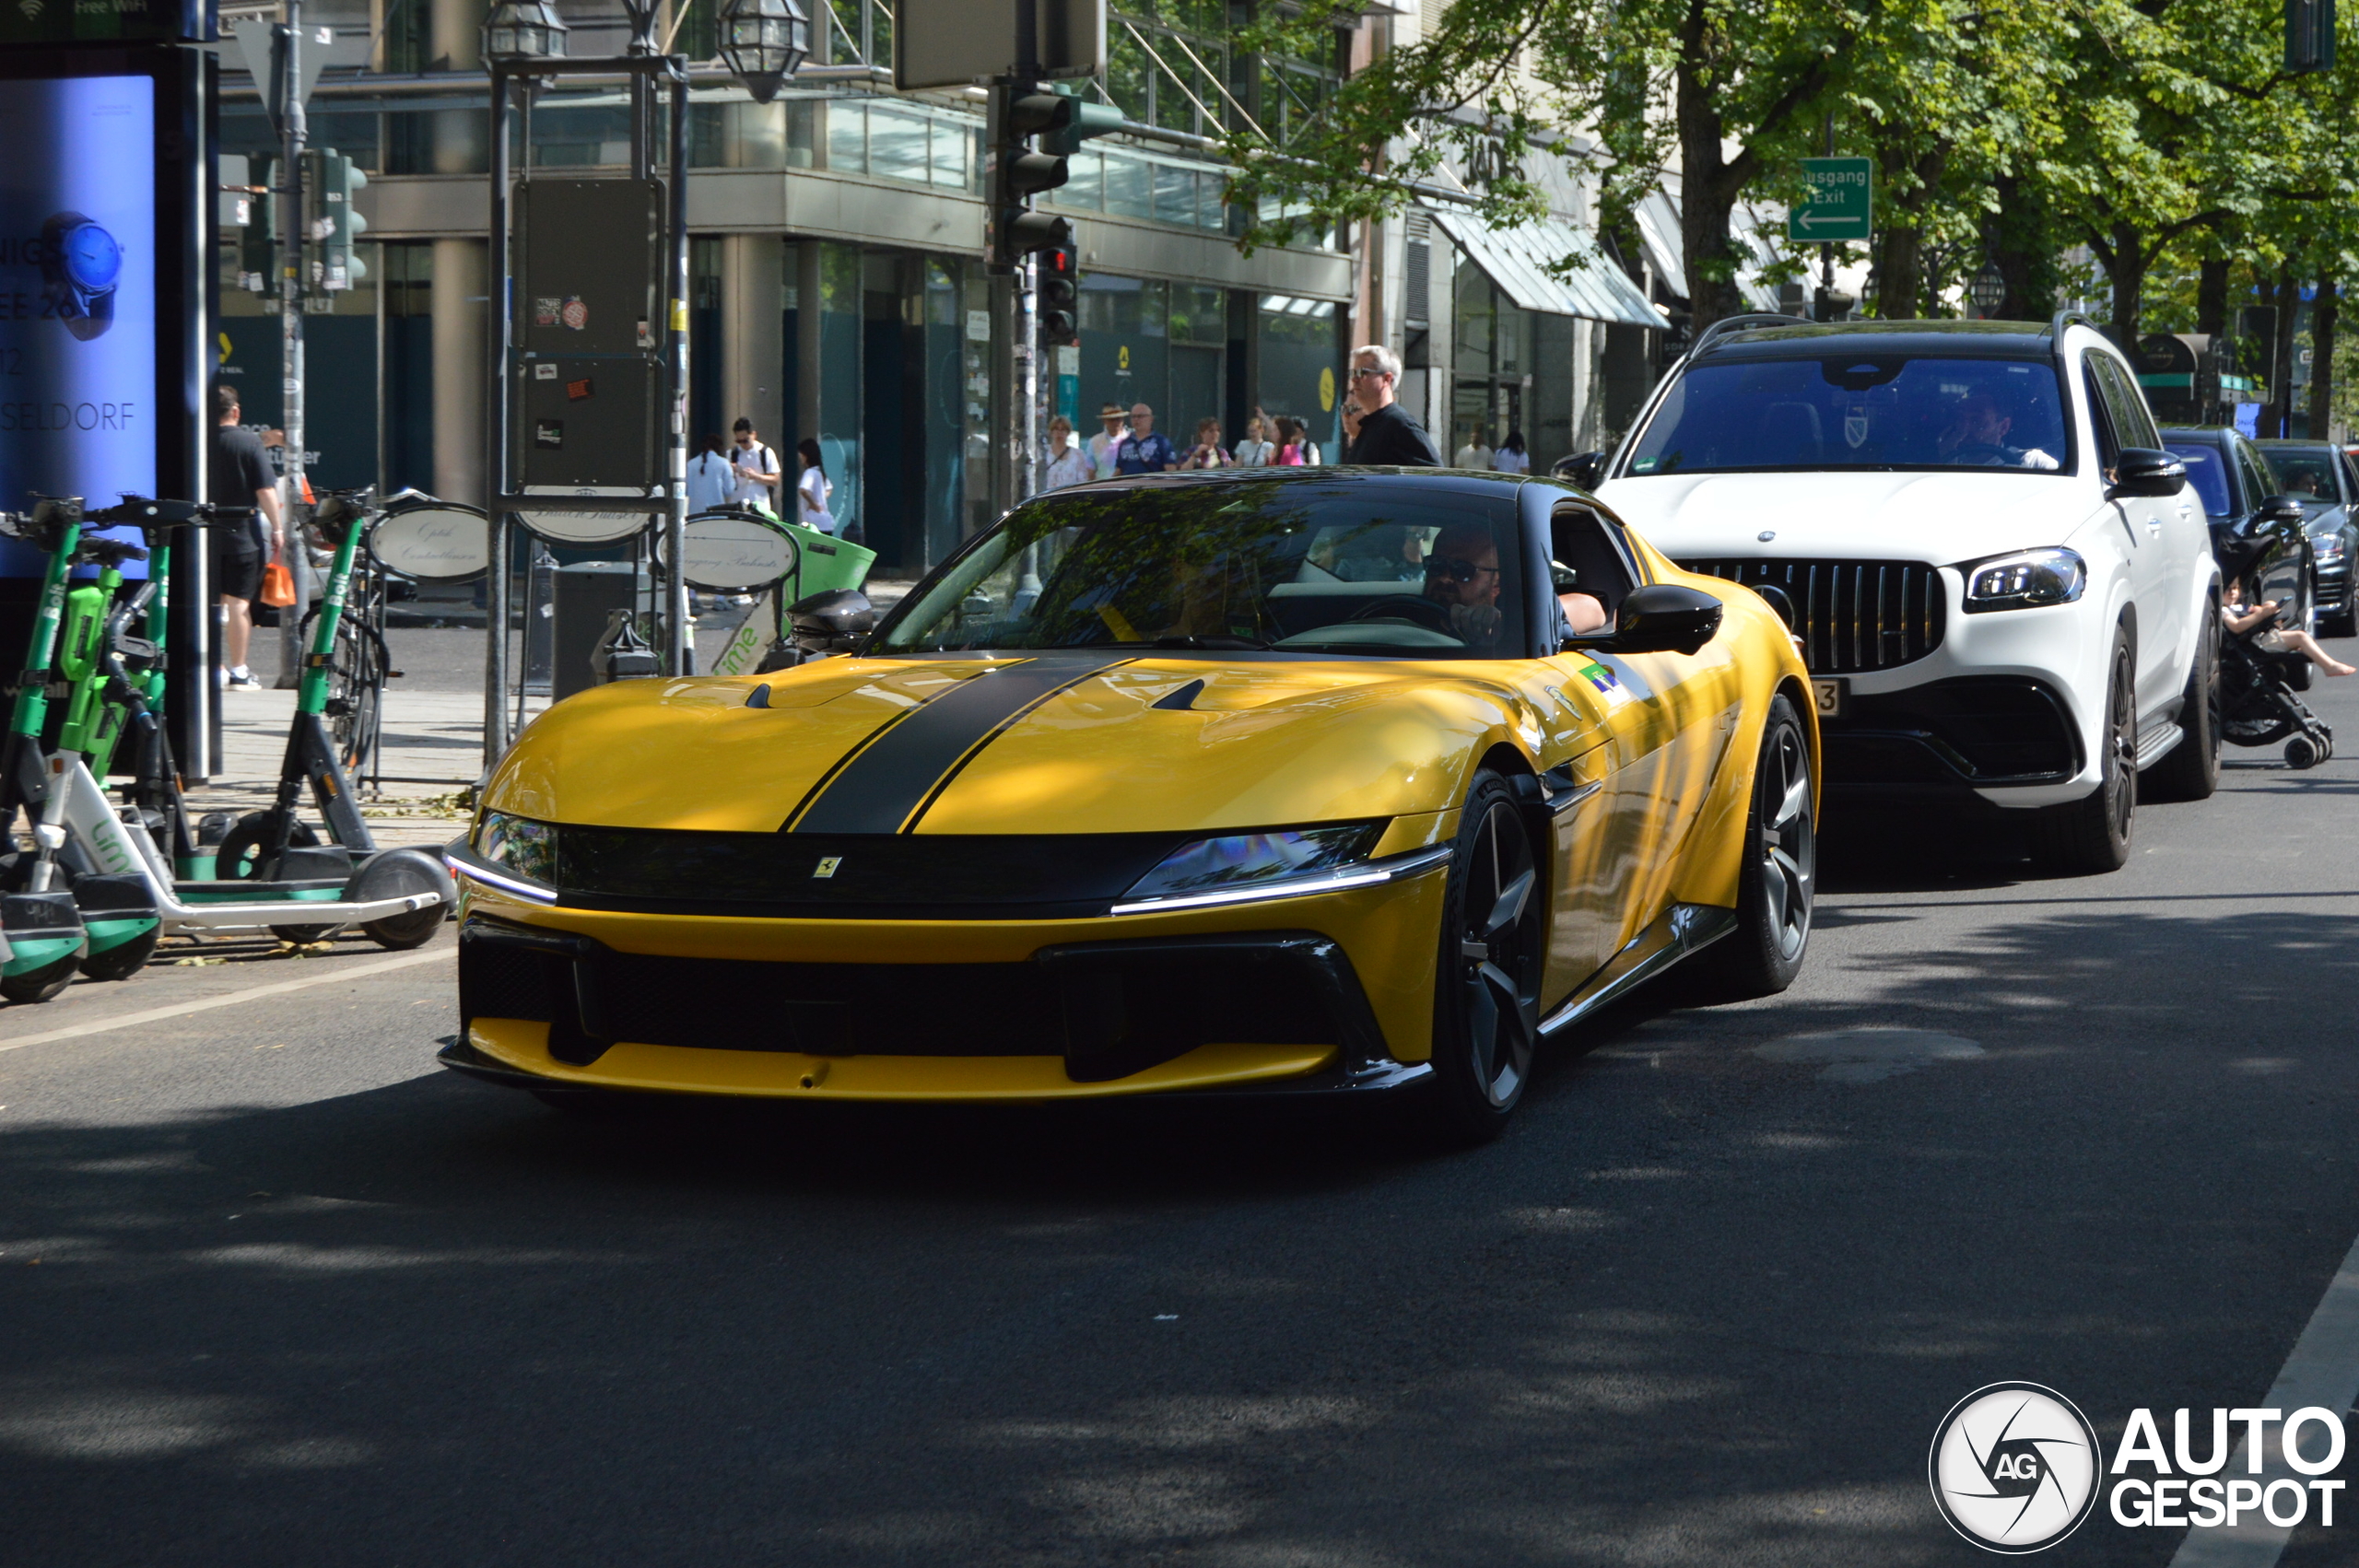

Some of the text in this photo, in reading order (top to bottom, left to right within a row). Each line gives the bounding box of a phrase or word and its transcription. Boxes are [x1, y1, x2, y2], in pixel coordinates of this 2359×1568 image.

[1813, 189, 1845, 204] Exit
[2, 403, 135, 430] SELDORF
[713, 627, 759, 676] ime
[90, 818, 136, 873] Lim
